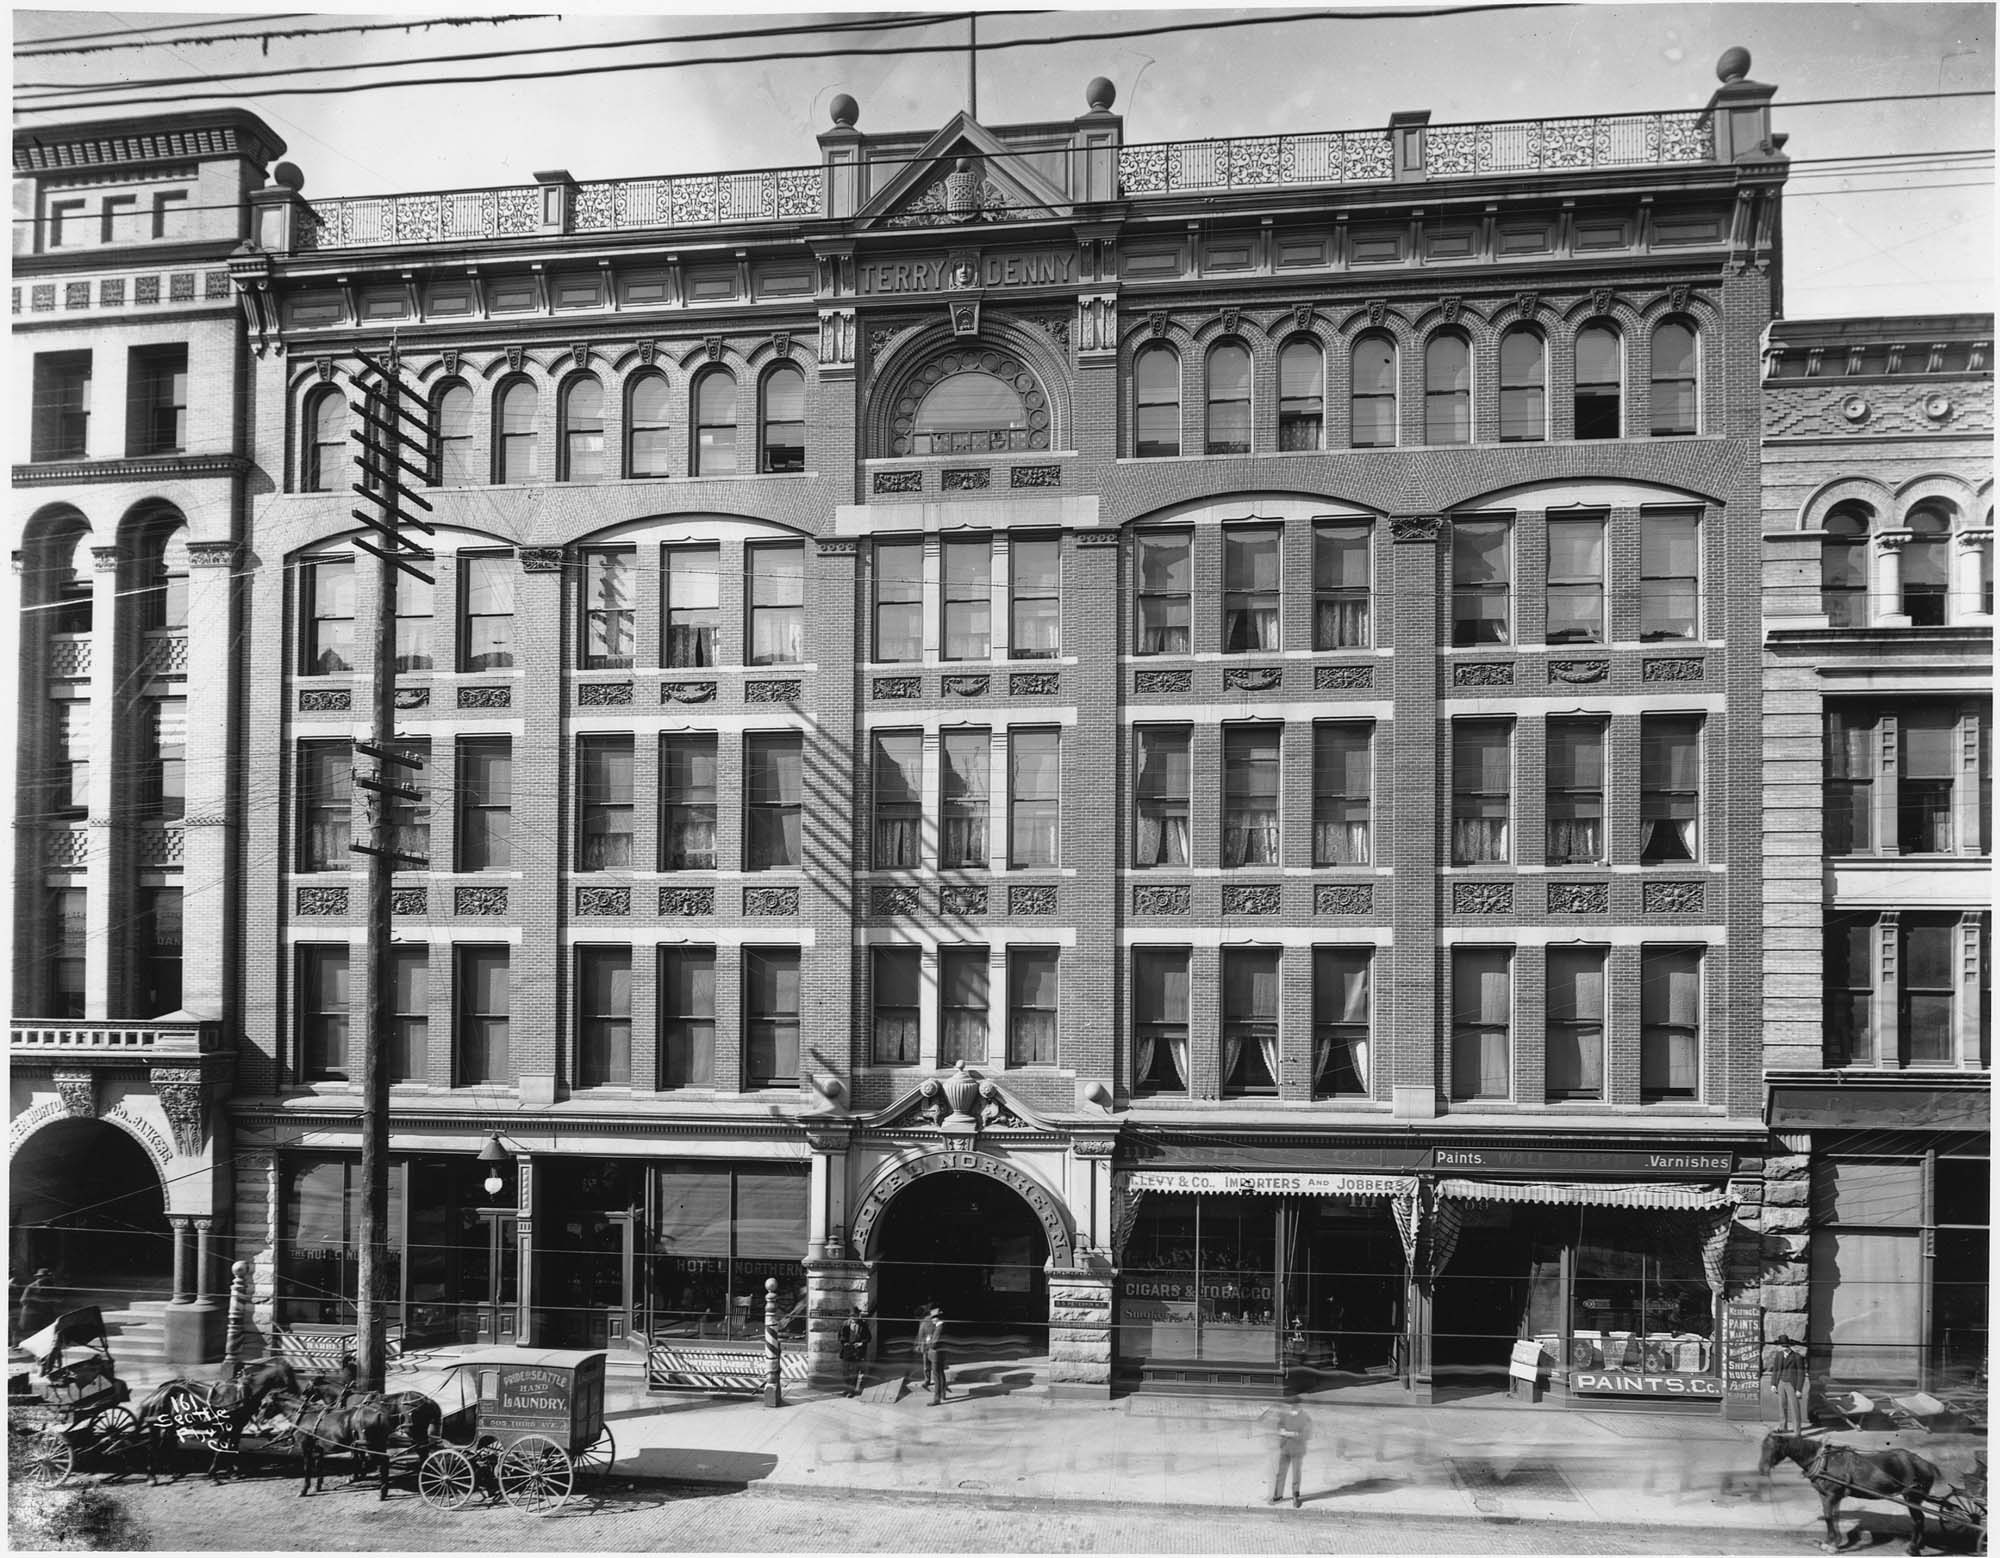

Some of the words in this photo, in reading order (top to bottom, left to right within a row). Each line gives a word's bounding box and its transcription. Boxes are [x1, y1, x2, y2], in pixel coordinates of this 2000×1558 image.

[860, 260, 947, 293] TERRY
[985, 253, 1074, 287] DENNY
[28, 1100, 67, 1125] HORTO
[1437, 1152, 1486, 1165] Paints.
[1179, 1175, 1189, 1187] &
[1225, 1176, 1300, 1190] IMPORTERS
[852, 1164, 924, 1245] HOTEL
[677, 1260, 728, 1273] HOTEL
[735, 1262, 804, 1276] NORTHERN
[1125, 1283, 1181, 1297] CIGARS
[1729, 1361, 1749, 1370] SHIP
[531, 1370, 568, 1388] SEATTLE
[1729, 1371, 1759, 1380] HOUSE
[520, 1384, 549, 1393] HAND
